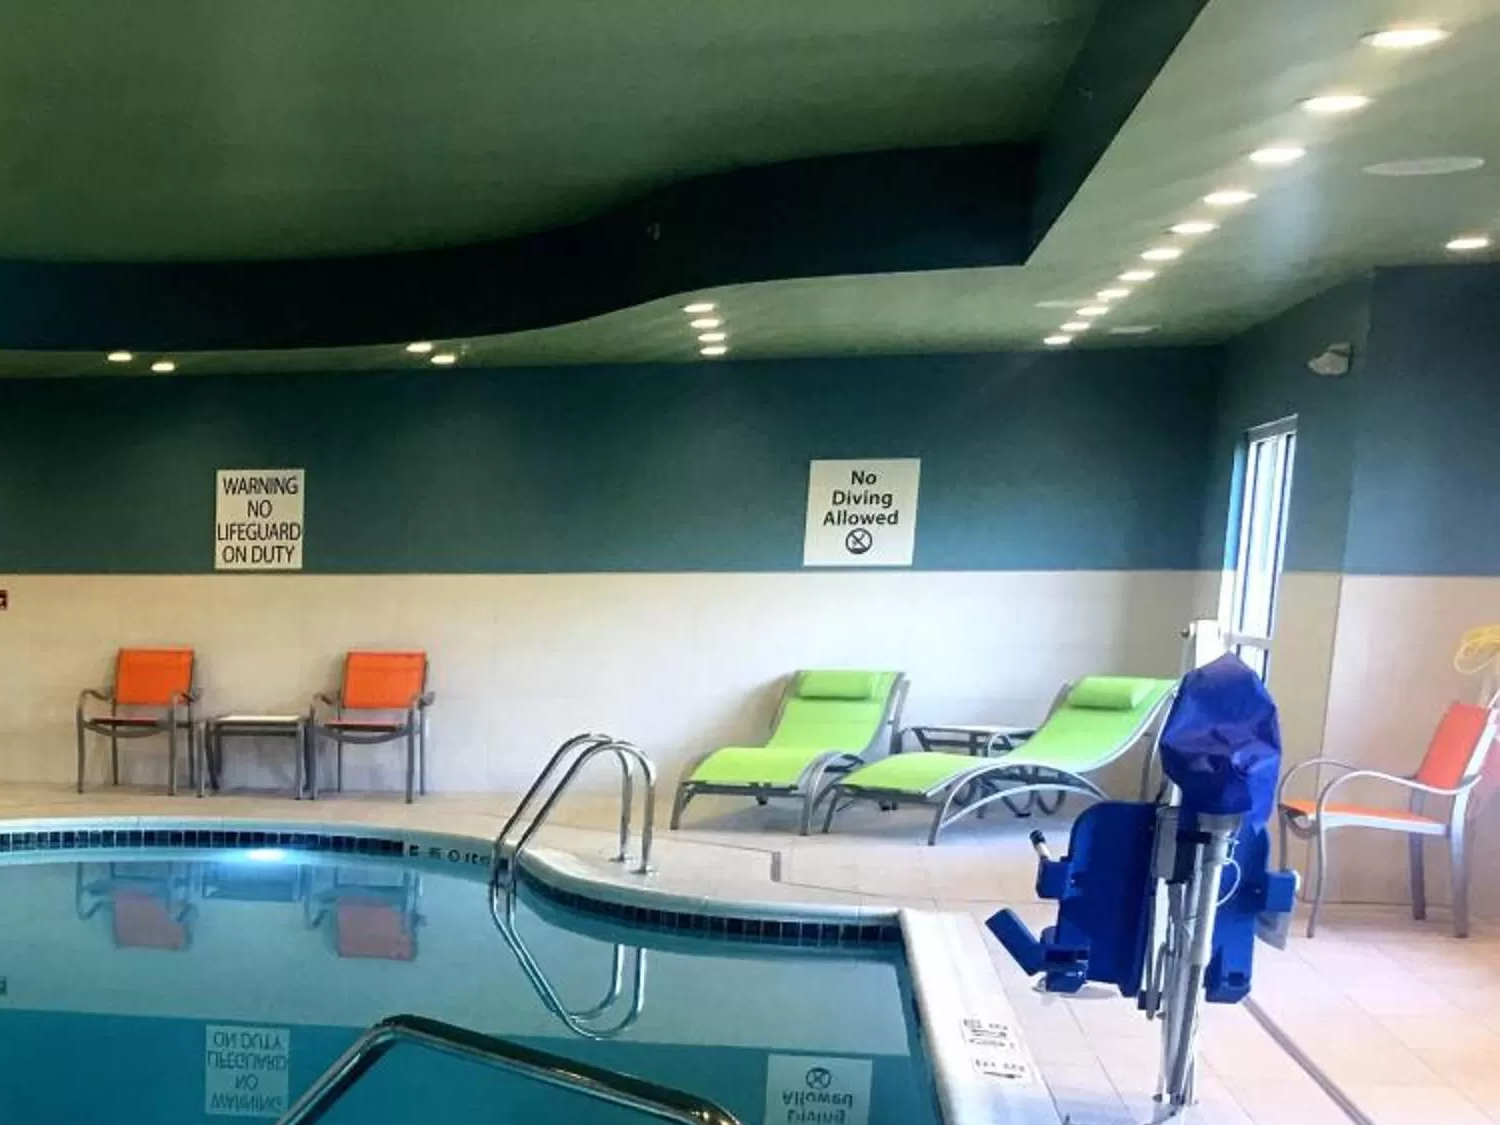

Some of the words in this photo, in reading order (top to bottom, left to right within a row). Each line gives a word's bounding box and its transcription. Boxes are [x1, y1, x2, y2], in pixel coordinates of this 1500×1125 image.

[222, 476, 298, 495] WARNING
[851, 469, 877, 485] No
[247, 499, 273, 518] NO
[832, 489, 893, 509] Diving
[823, 509, 899, 526] Allowed
[217, 522, 301, 541] LIFEGUARD
[222, 545, 247, 562] ON
[251, 545, 295, 563] DUTY
